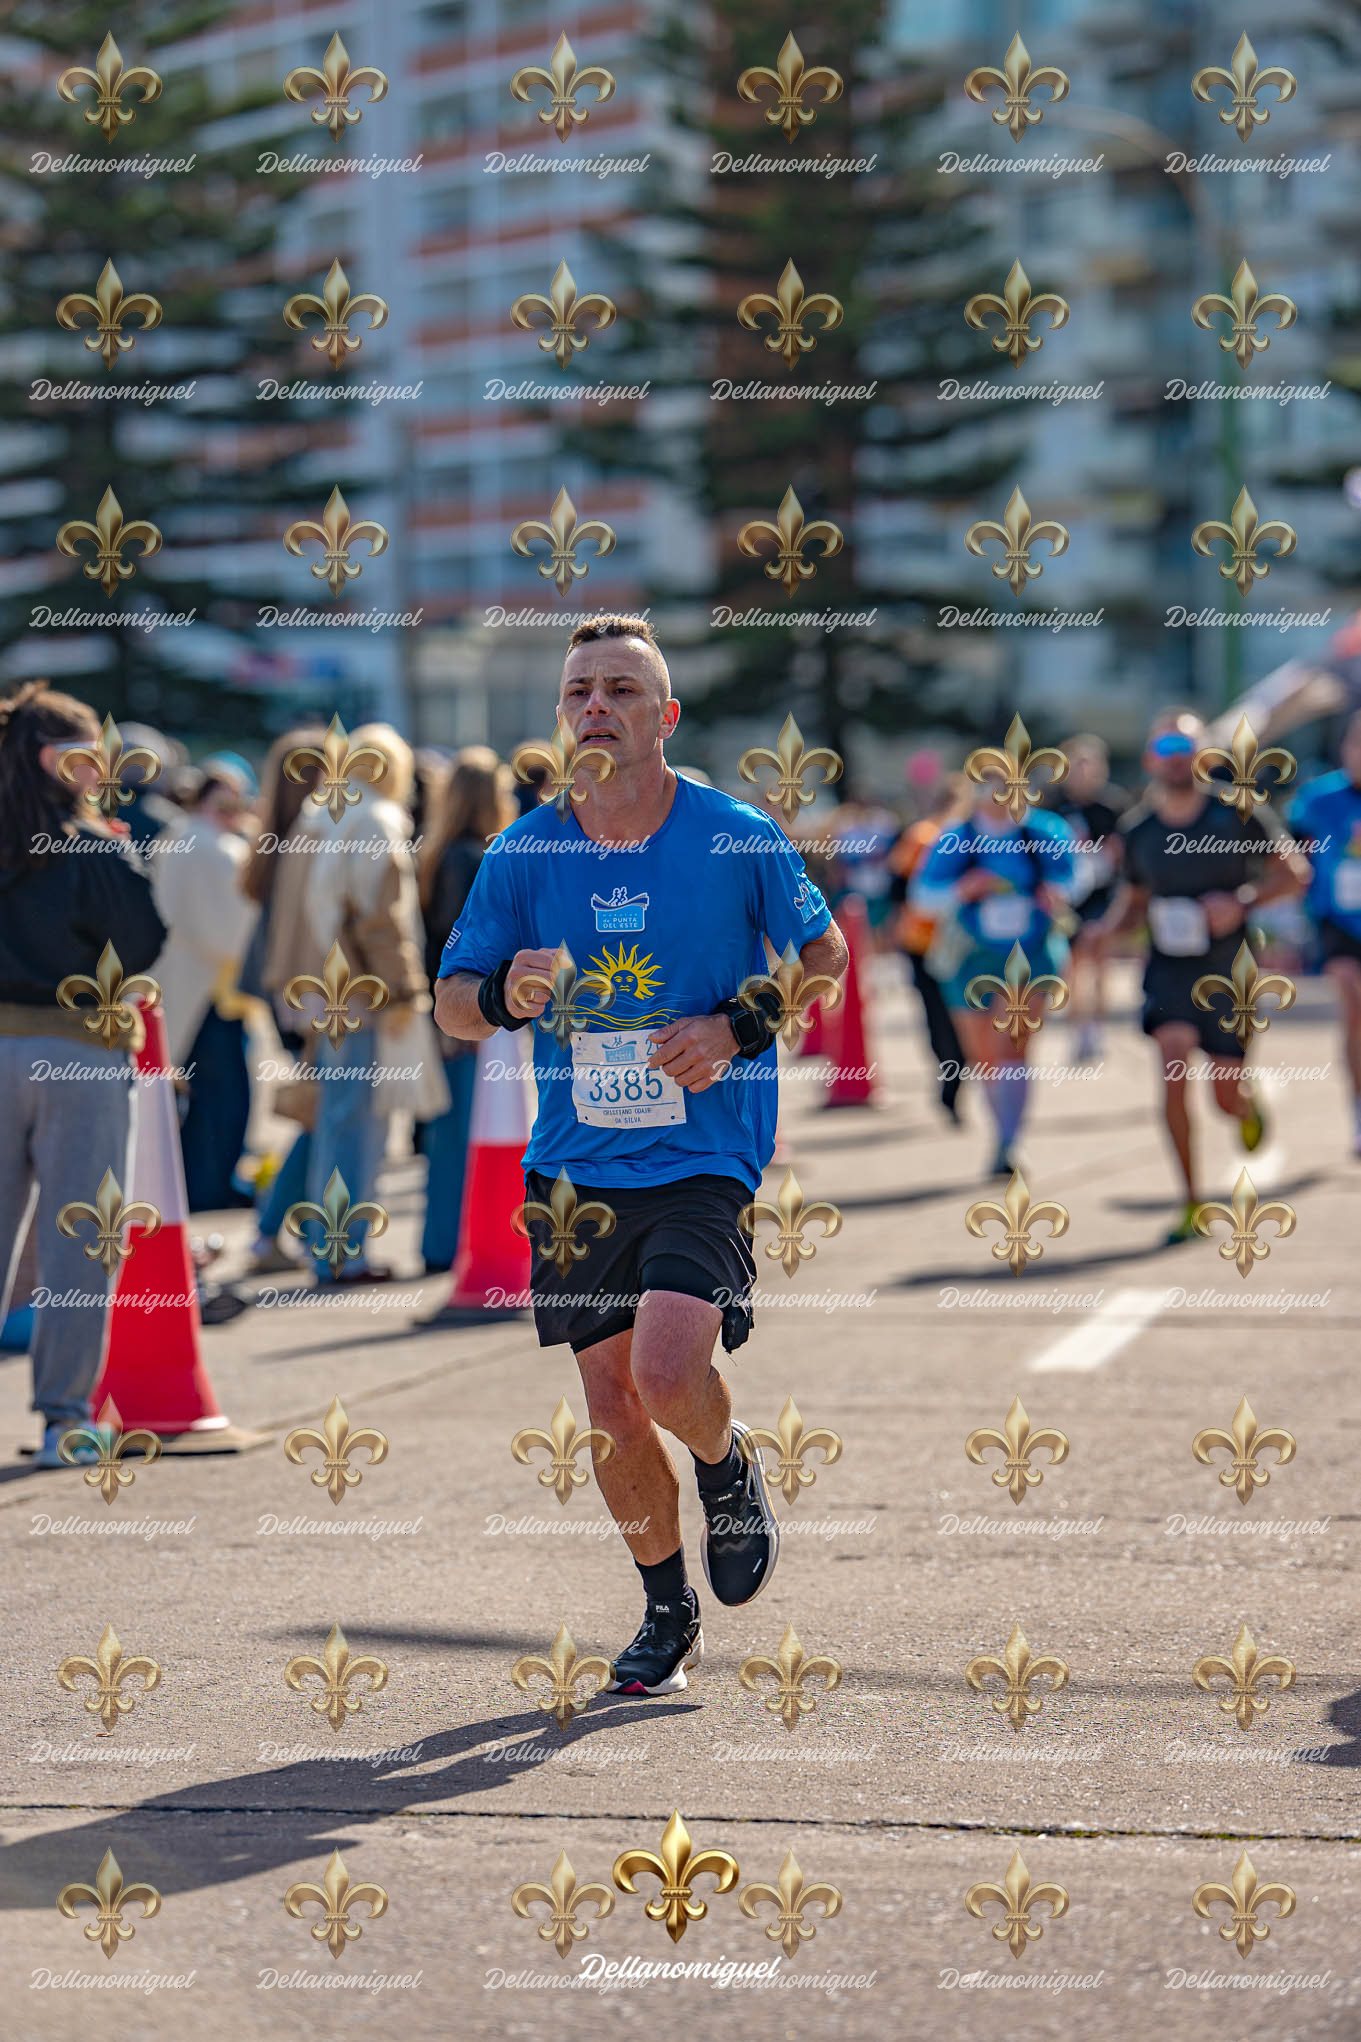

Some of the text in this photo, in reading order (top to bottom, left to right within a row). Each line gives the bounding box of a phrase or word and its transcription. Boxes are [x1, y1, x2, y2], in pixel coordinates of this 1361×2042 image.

[589, 1068, 663, 1102] 3385
[624, 1116, 641, 1124] SILVA
[717, 1493, 733, 1502] FILA
